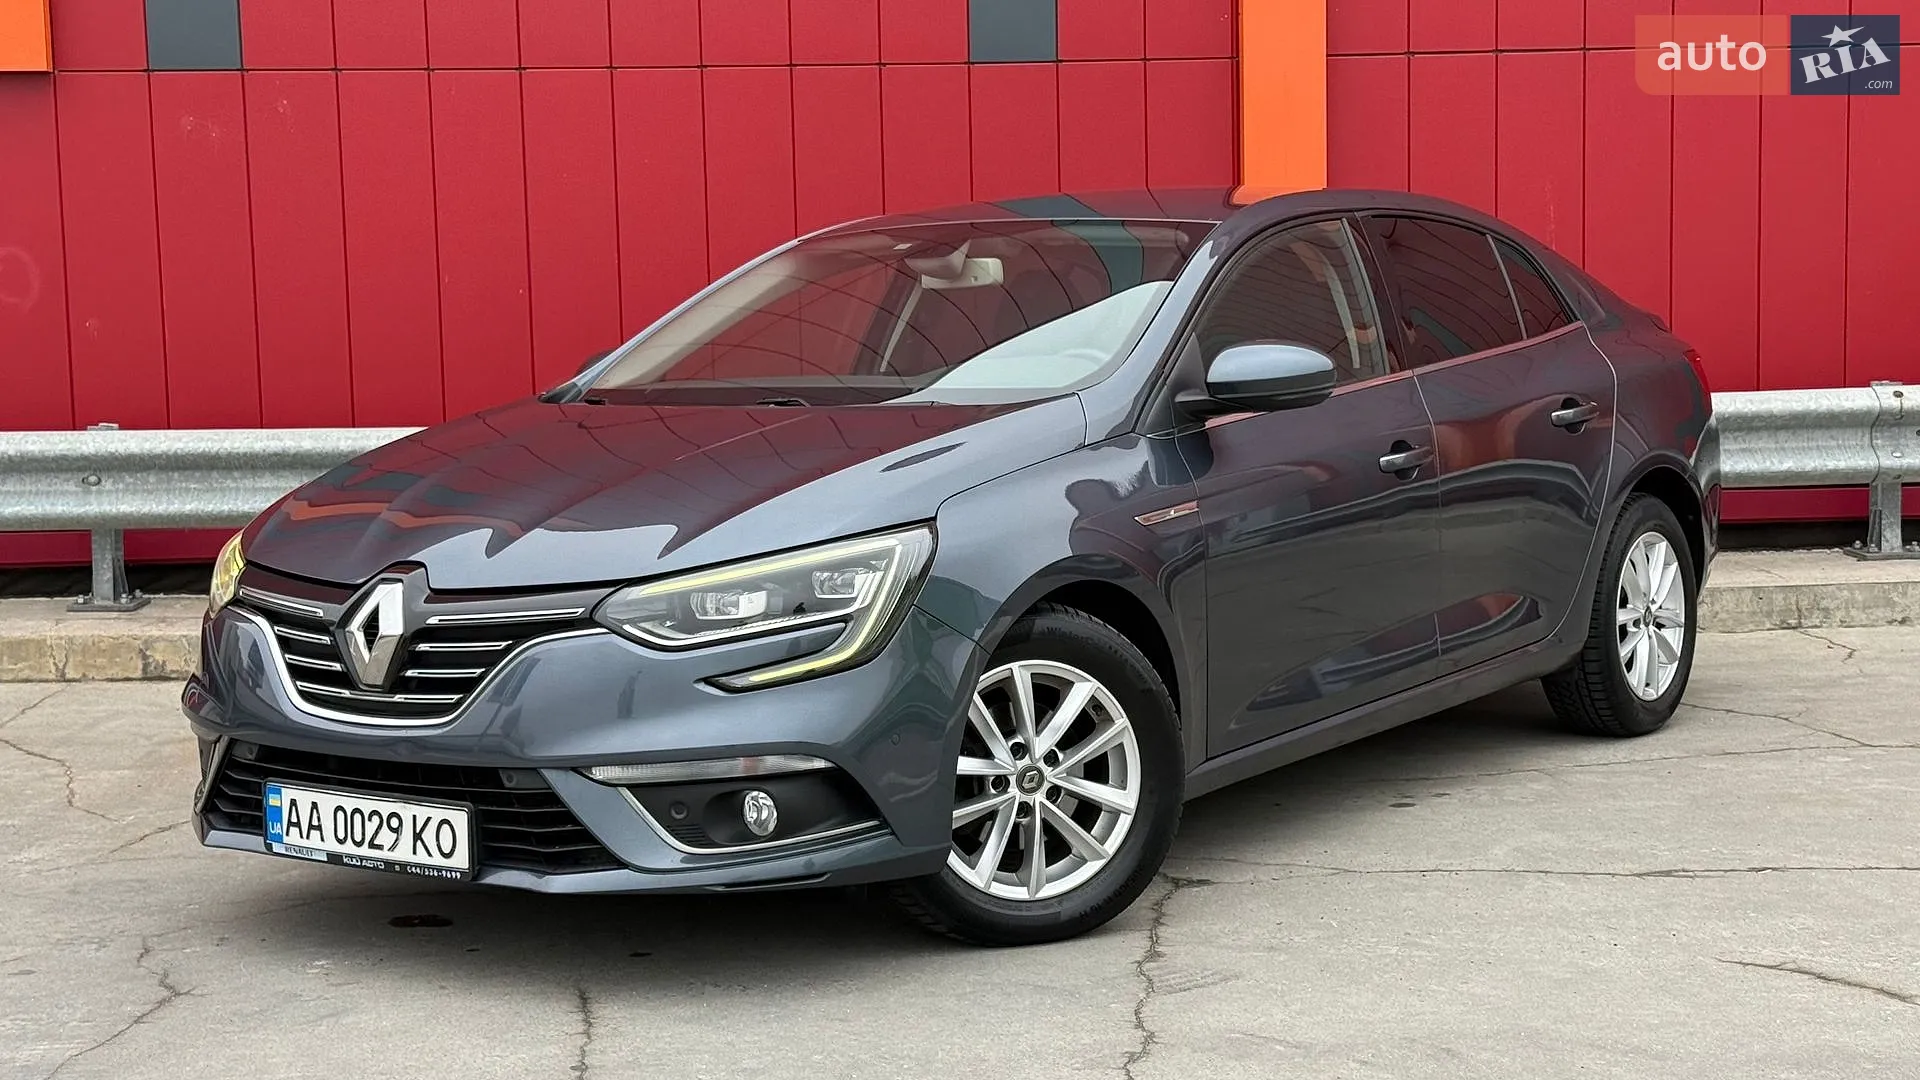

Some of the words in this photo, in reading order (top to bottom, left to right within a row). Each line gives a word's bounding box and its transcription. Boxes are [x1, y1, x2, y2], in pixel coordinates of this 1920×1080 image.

[269, 821, 283, 834] UA
[285, 797, 326, 843] AA
[333, 805, 404, 852] 0029
[412, 814, 457, 859] KO
